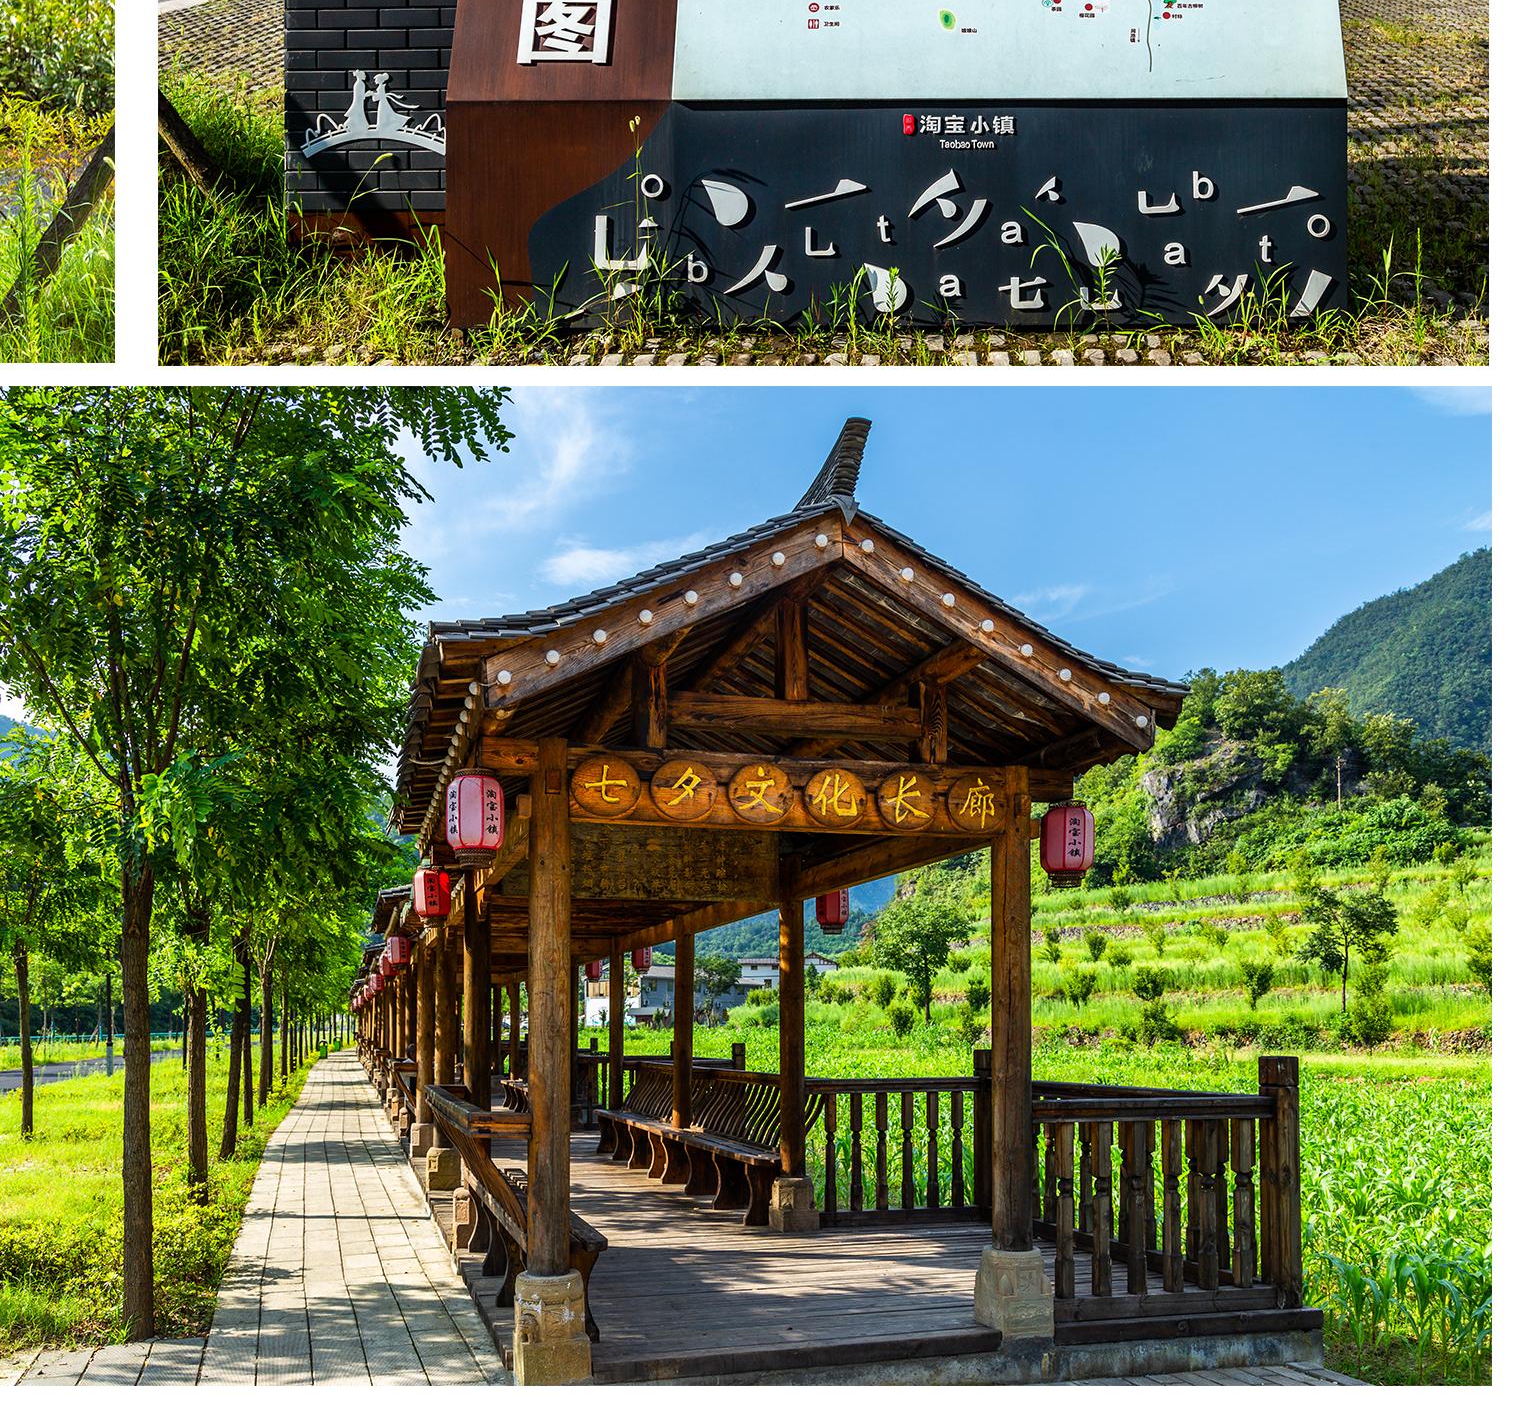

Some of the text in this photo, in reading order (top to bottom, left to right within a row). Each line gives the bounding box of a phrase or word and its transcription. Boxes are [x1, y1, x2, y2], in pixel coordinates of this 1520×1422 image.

[920, 115, 1014, 134] 淘宝小镇
[940, 140, 994, 149] Taobao Town
[585, 764, 996, 829] 七夕文化长廊
